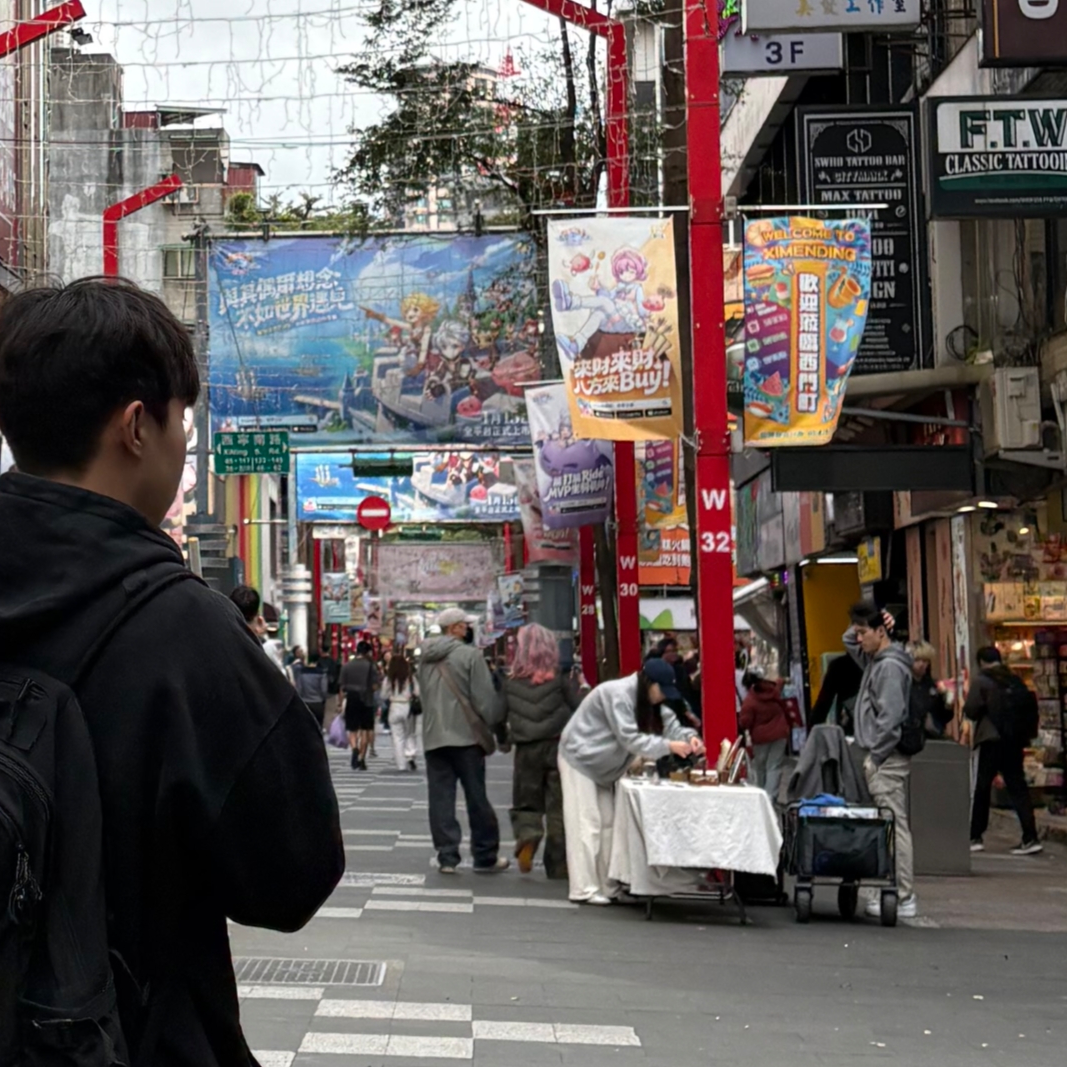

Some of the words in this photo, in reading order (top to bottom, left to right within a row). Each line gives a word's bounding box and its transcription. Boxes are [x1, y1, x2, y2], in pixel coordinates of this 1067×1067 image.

[845, 155, 883, 167] TATTOO
[885, 154, 906, 166] BAR
[945, 153, 1003, 174] CLASSIC
[821, 190, 850, 202] MAX
[853, 189, 902, 201] TATTOO
[761, 227, 832, 241] WELCOME
[835, 230, 855, 242] TO
[763, 245, 856, 262] XIMENDING
[701, 489, 726, 510] W
[701, 531, 730, 553] 32
[620, 556, 636, 570] W
[582, 585, 594, 596] W
[619, 583, 639, 597] 30
[581, 604, 595, 615] 28
